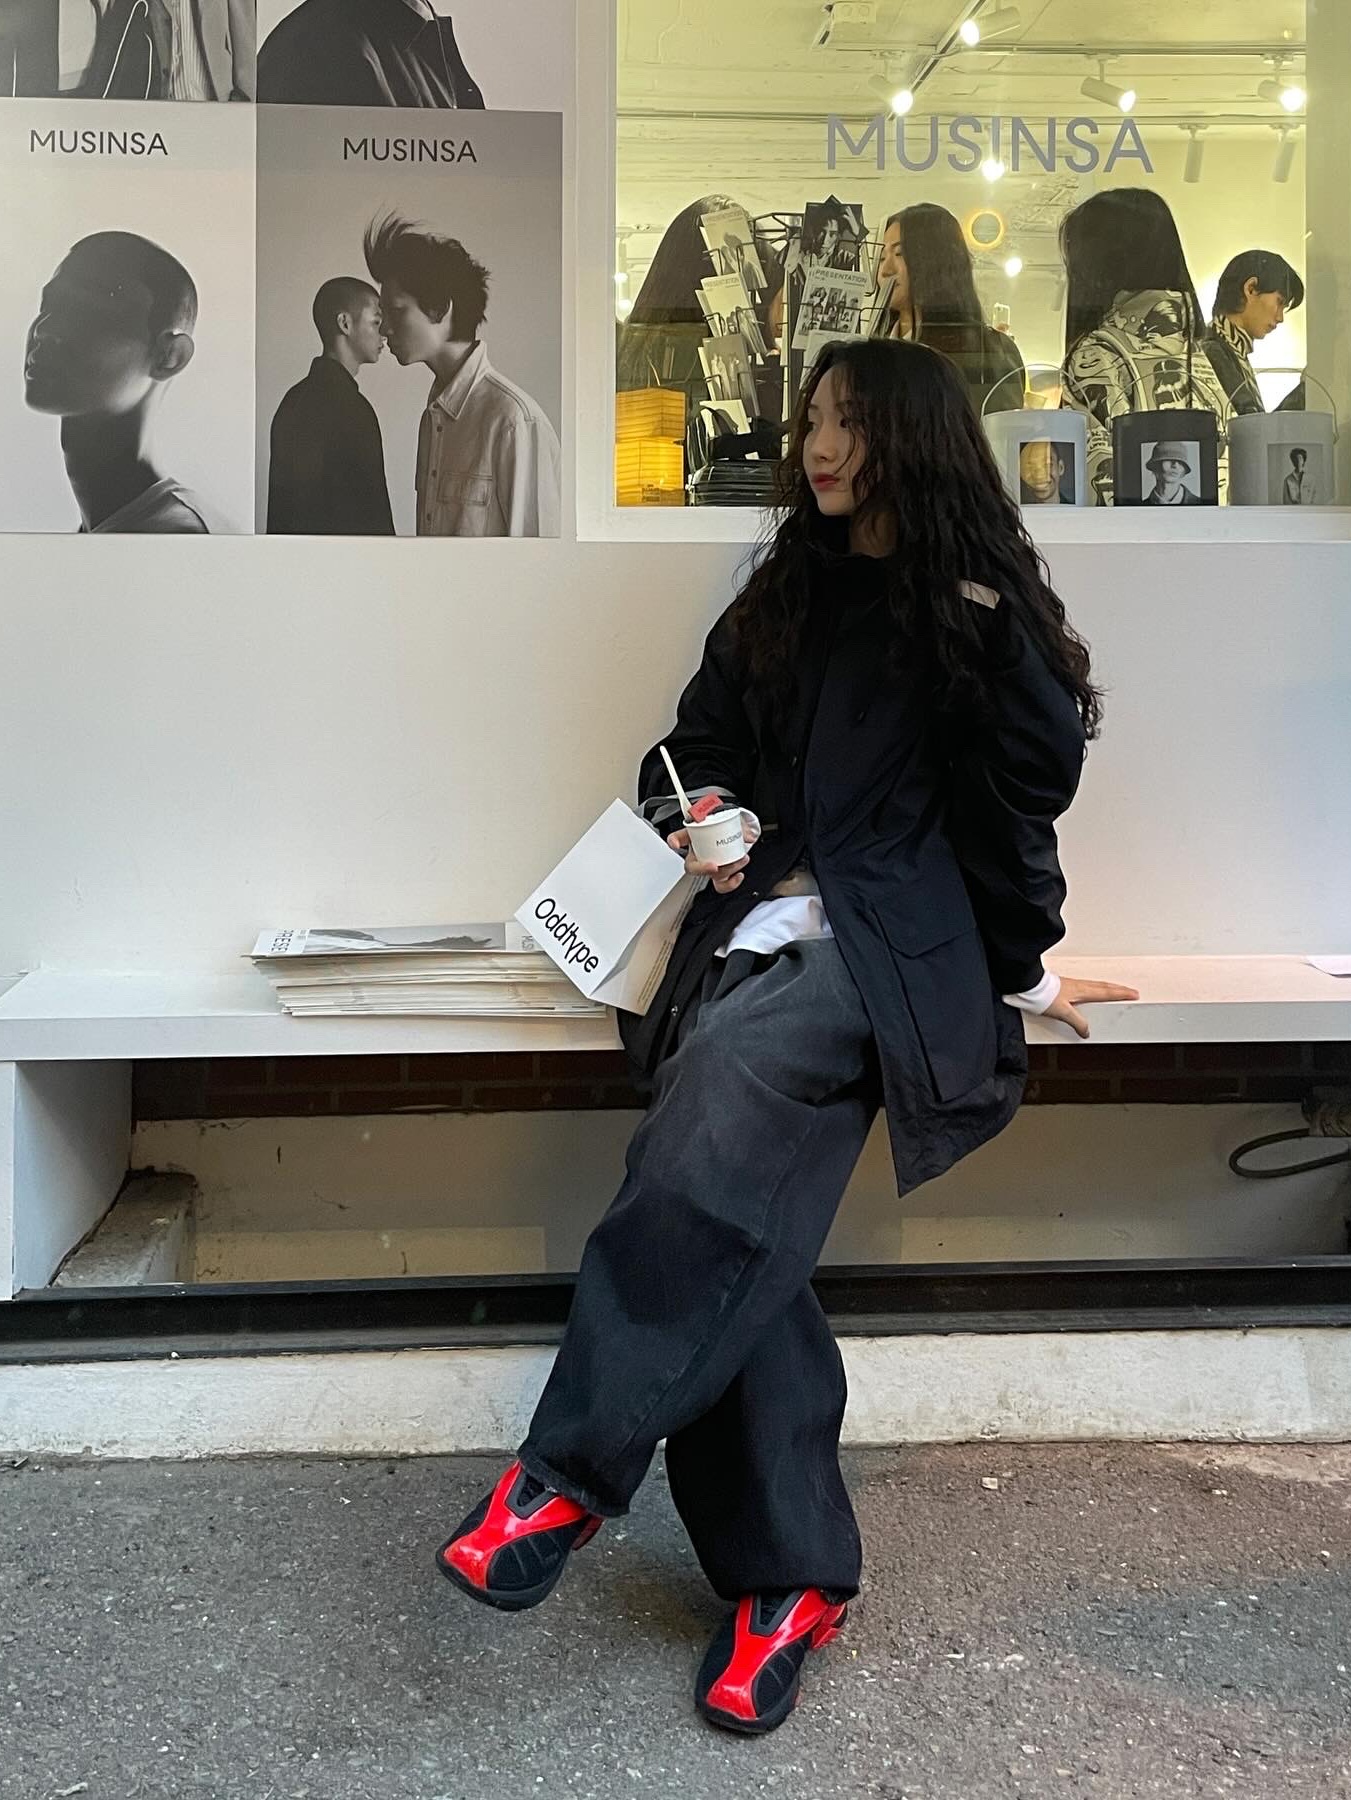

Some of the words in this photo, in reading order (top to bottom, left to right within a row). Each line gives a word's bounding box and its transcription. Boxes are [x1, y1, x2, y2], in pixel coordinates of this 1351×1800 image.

[30, 129, 168, 156] MUSINSA
[343, 137, 477, 163] MUSINSA
[827, 115, 1154, 174] MUSINSA
[815, 268, 867, 284] PRESENTATION
[534, 897, 600, 973] Oddtype
